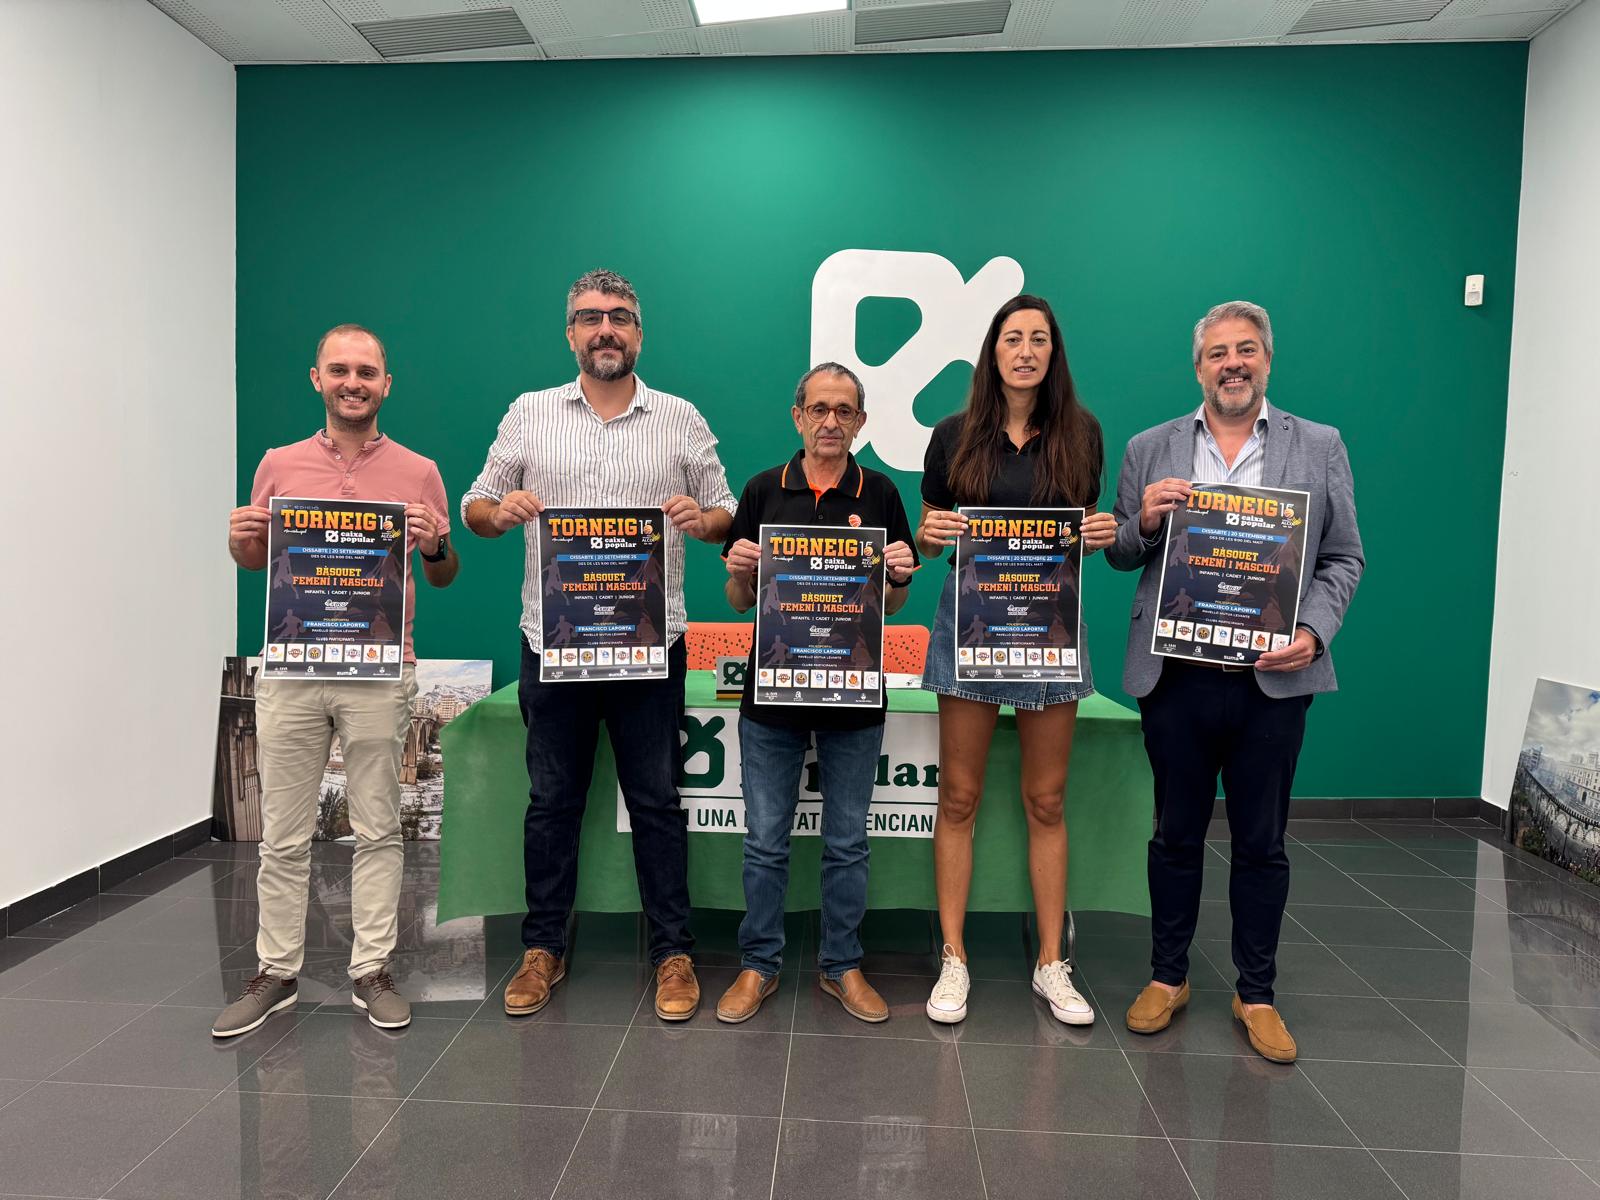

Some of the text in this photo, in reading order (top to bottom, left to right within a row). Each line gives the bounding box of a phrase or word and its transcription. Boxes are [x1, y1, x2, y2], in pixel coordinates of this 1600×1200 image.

[1187, 490, 1278, 517] TORNEIG
[281, 509, 377, 530] TORNEIG
[1240, 520, 1276, 528] popular
[548, 518, 638, 536] TORNEIG
[968, 520, 1055, 537] TORNEIG
[770, 537, 858, 557] TORNEIG
[1213, 546, 1258, 561] BÀSQUET
[1188, 555, 1226, 568] FEMENÍ
[1235, 561, 1280, 574] MASCULÍ
[316, 566, 361, 576] BÀSQUET
[584, 572, 626, 582] BÀSQUET
[292, 575, 383, 587] FEMENÍ I MASCULÍ
[999, 573, 1040, 582] BÀSQUET
[562, 581, 646, 592] FEMENÍ I MASCULÍ
[979, 582, 1060, 592] FEMENÍ I MASCULÍ
[802, 592, 843, 603] BÀSQUET
[780, 602, 864, 613] FEMENÍ I MASCULÍ
[697, 808, 933, 832] UNA ENCIAN
